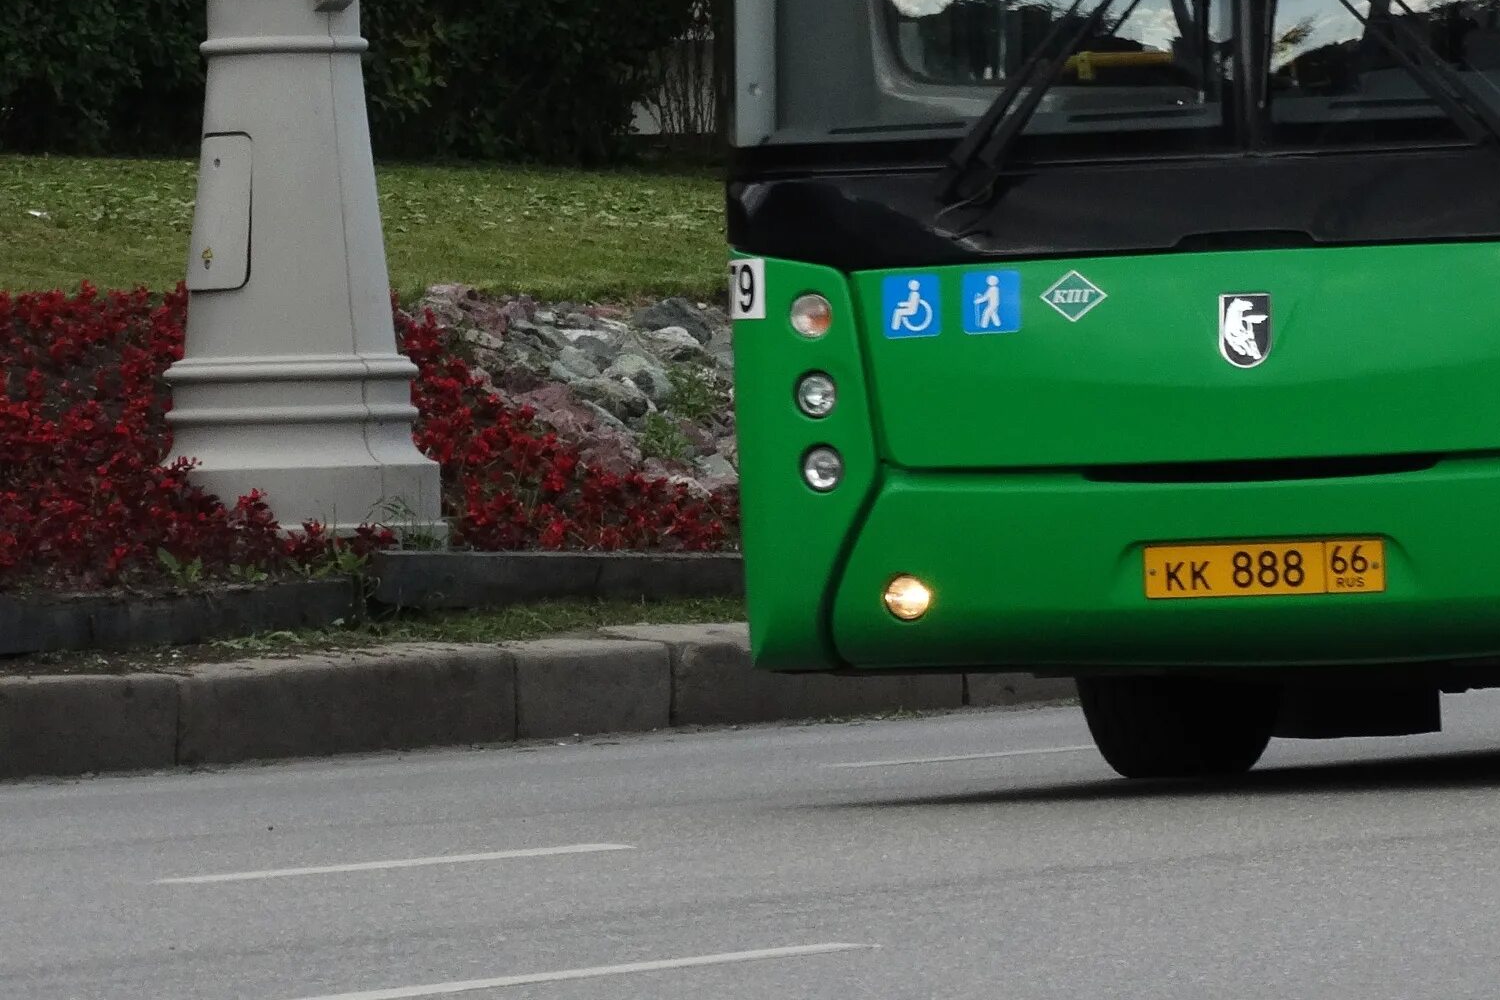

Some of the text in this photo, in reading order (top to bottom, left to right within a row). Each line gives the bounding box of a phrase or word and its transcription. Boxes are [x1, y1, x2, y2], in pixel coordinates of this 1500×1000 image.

[1164, 545, 1369, 592] КК 888 66
[1335, 576, 1366, 588] RUS
